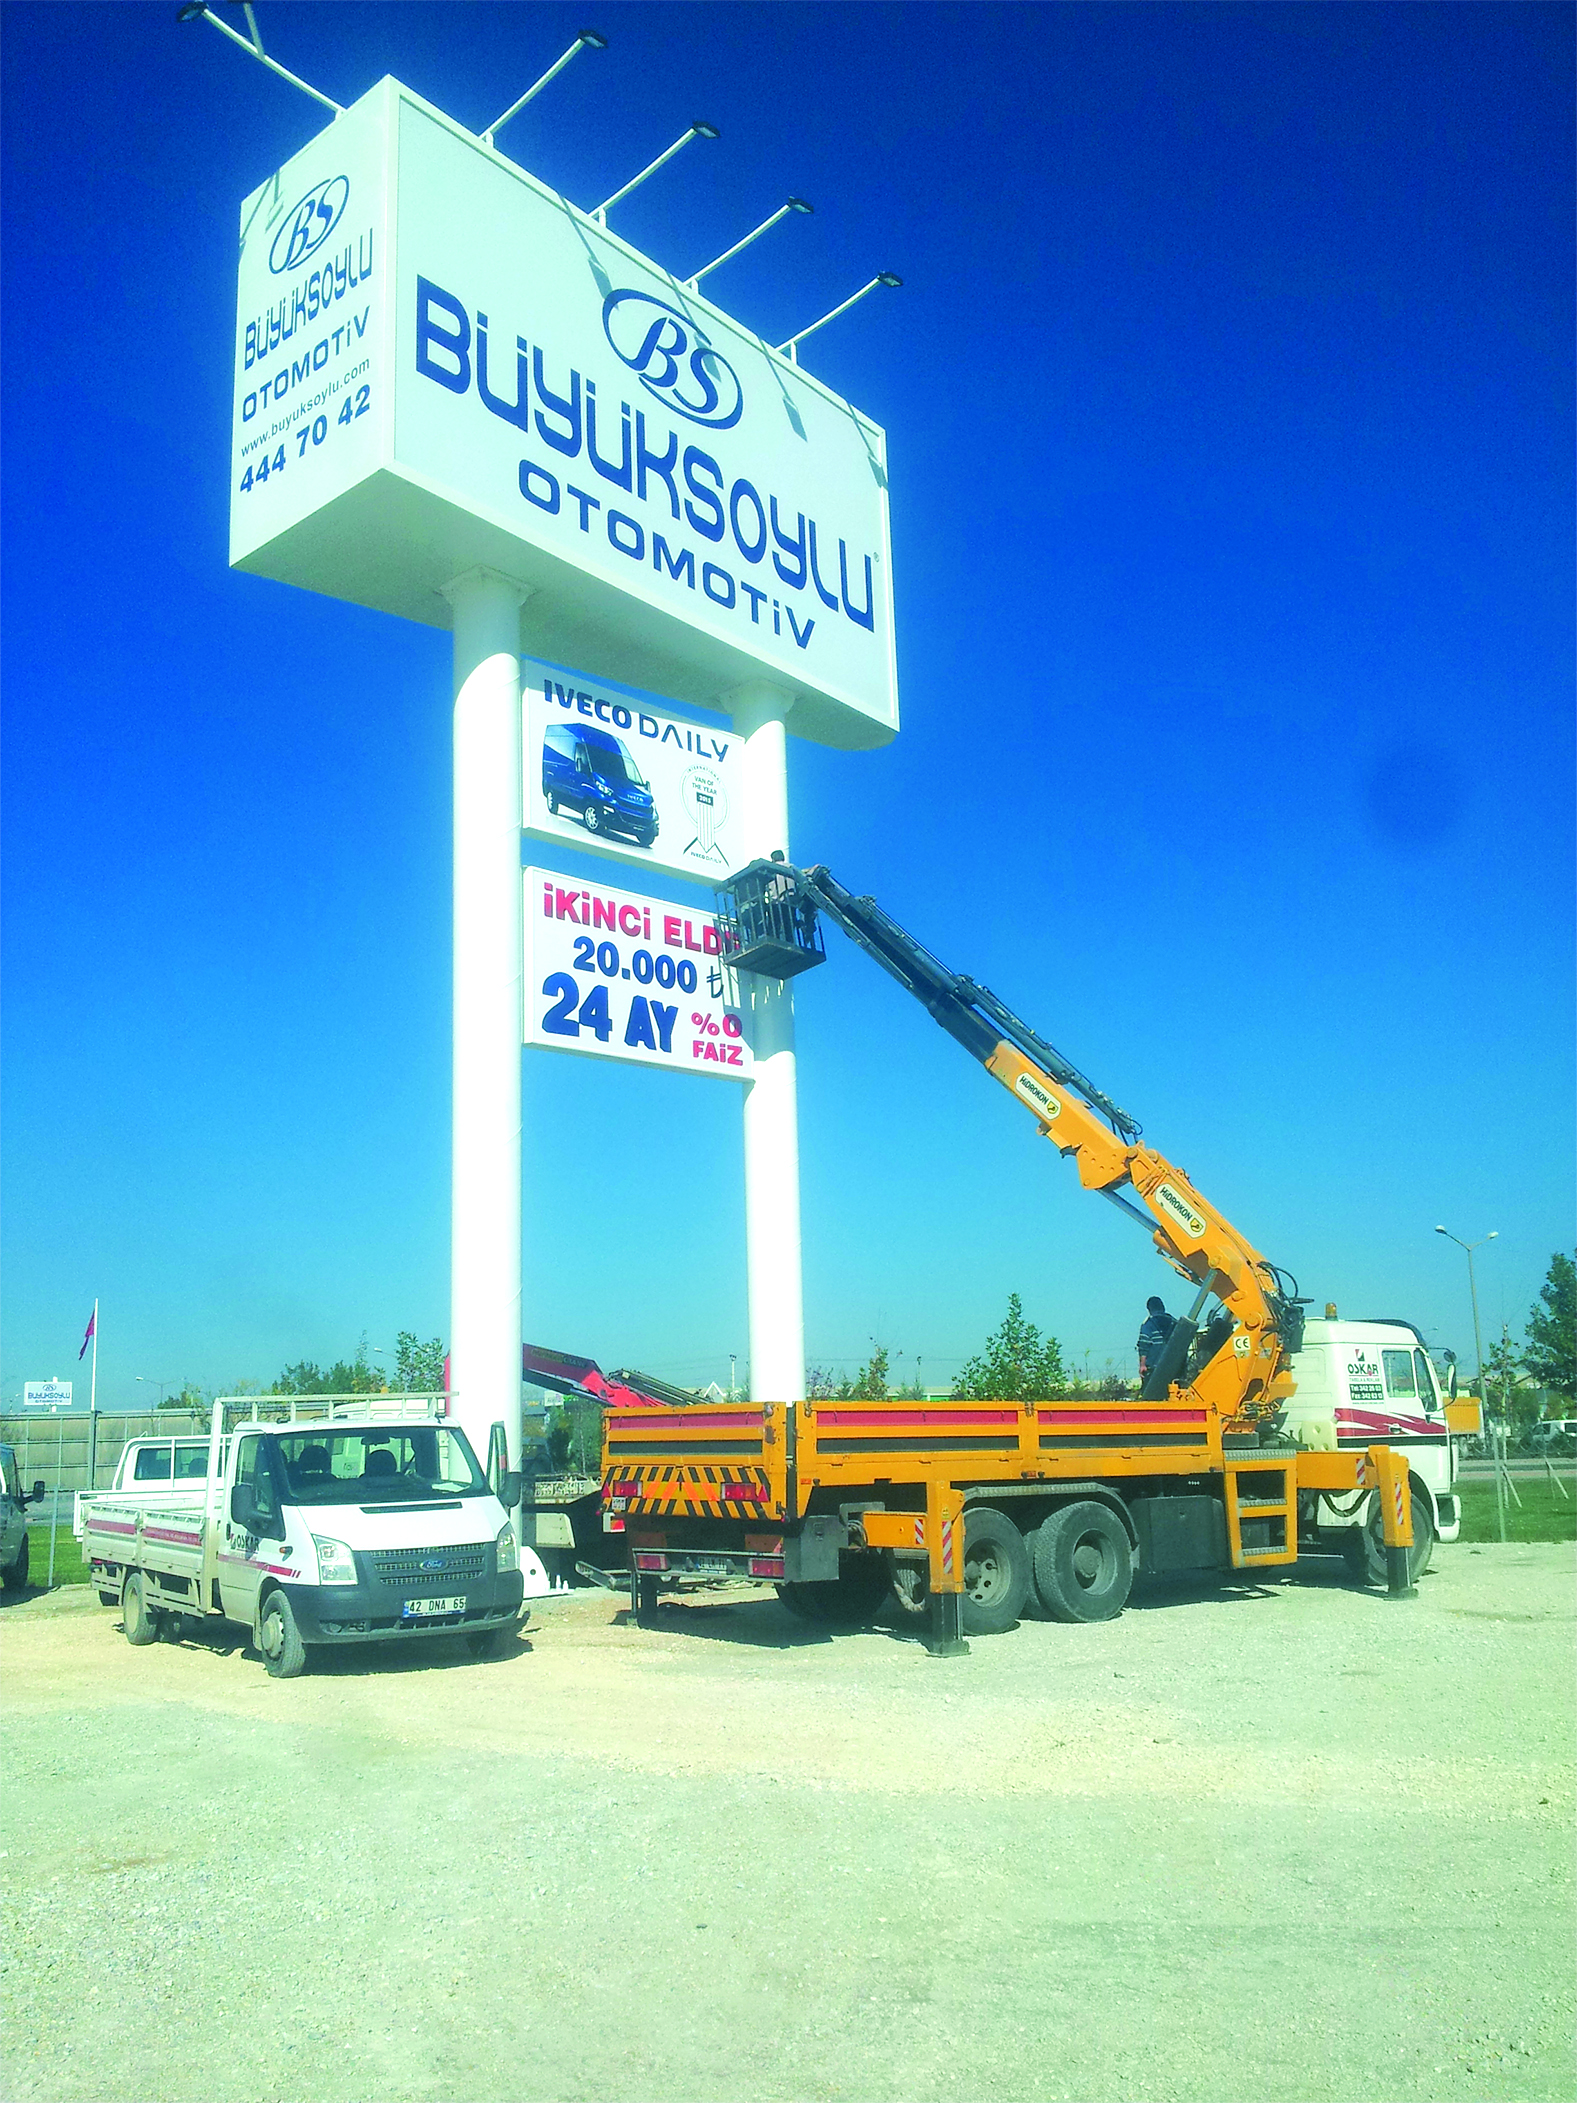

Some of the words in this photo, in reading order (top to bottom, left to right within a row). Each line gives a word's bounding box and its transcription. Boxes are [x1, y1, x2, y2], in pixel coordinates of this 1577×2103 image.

[241, 359, 370, 457] www.buyuksoylu.com
[240, 443, 286, 493] 444
[296, 414, 327, 458] 70
[338, 384, 371, 425] 42
[416, 274, 874, 633] BÜYÜKSOYLU
[544, 679, 632, 729] IVECO
[639, 713, 729, 763] DAILY
[692, 782, 702, 791] THE
[703, 786, 717, 795] YEAR
[694, 776, 706, 784] VAN
[664, 914, 741, 956] ELD
[573, 936, 697, 994] 20.000
[542, 972, 613, 1042] 24
[624, 995, 679, 1053] AY
[1347, 1363, 1379, 1375] OSKAR
[409, 1601, 422, 1612] 42
[428, 1599, 446, 1611] DNA
[453, 1598, 465, 1609] 65
